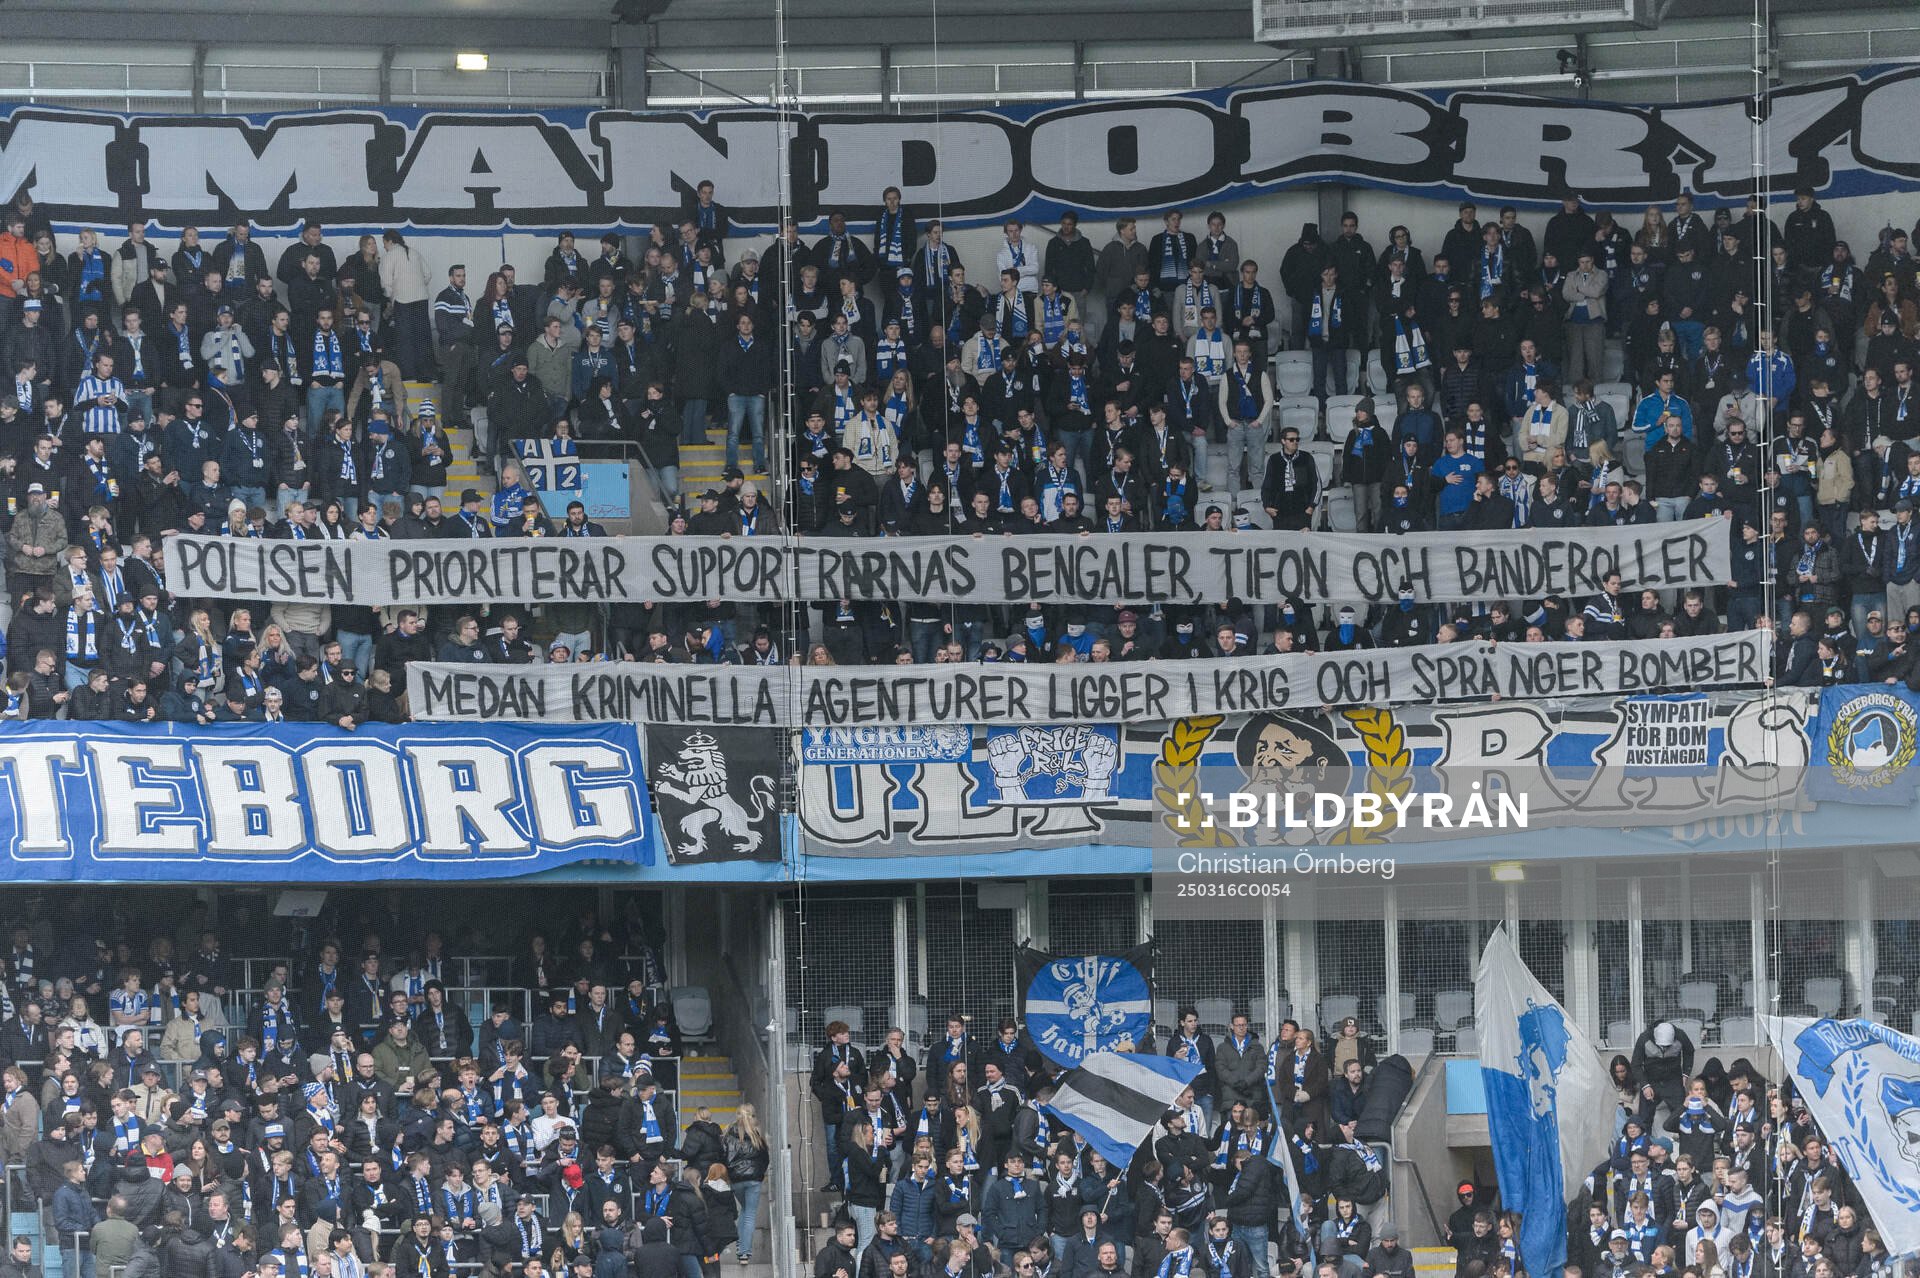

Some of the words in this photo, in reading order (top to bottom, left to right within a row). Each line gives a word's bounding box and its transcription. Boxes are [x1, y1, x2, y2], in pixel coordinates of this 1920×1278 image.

[561, 465, 578, 488] 2
[177, 539, 354, 601] POLISEN
[389, 546, 627, 599] PRIORITERAR
[652, 543, 976, 598] SUPPORTRARNAS
[1002, 543, 1204, 604] BENGALER,
[1209, 546, 1329, 600] TIFON
[1353, 547, 1432, 600] OCH
[1455, 533, 1714, 598] BANDEROLLER
[422, 671, 546, 718] MEDAN
[572, 674, 776, 724] KRIMINELLA
[805, 674, 1030, 725] AGENTURER
[1049, 672, 1169, 719] LIGGER
[1186, 671, 1198, 714] I
[1214, 667, 1290, 711] KRIG
[1317, 660, 1390, 704] OCH
[1412, 647, 1604, 697] SPRÄNGER
[1619, 642, 1758, 689] BOMBER
[1628, 702, 1707, 724] SYMPATI
[1837, 693, 1896, 721] GÖTEBORGS
[806, 726, 924, 745] YNGRE
[1627, 723, 1661, 746] FÖR
[1666, 726, 1706, 746] DOM
[805, 746, 927, 761] GENERATIONEN
[1626, 747, 1705, 764] AVSTÄNGDA
